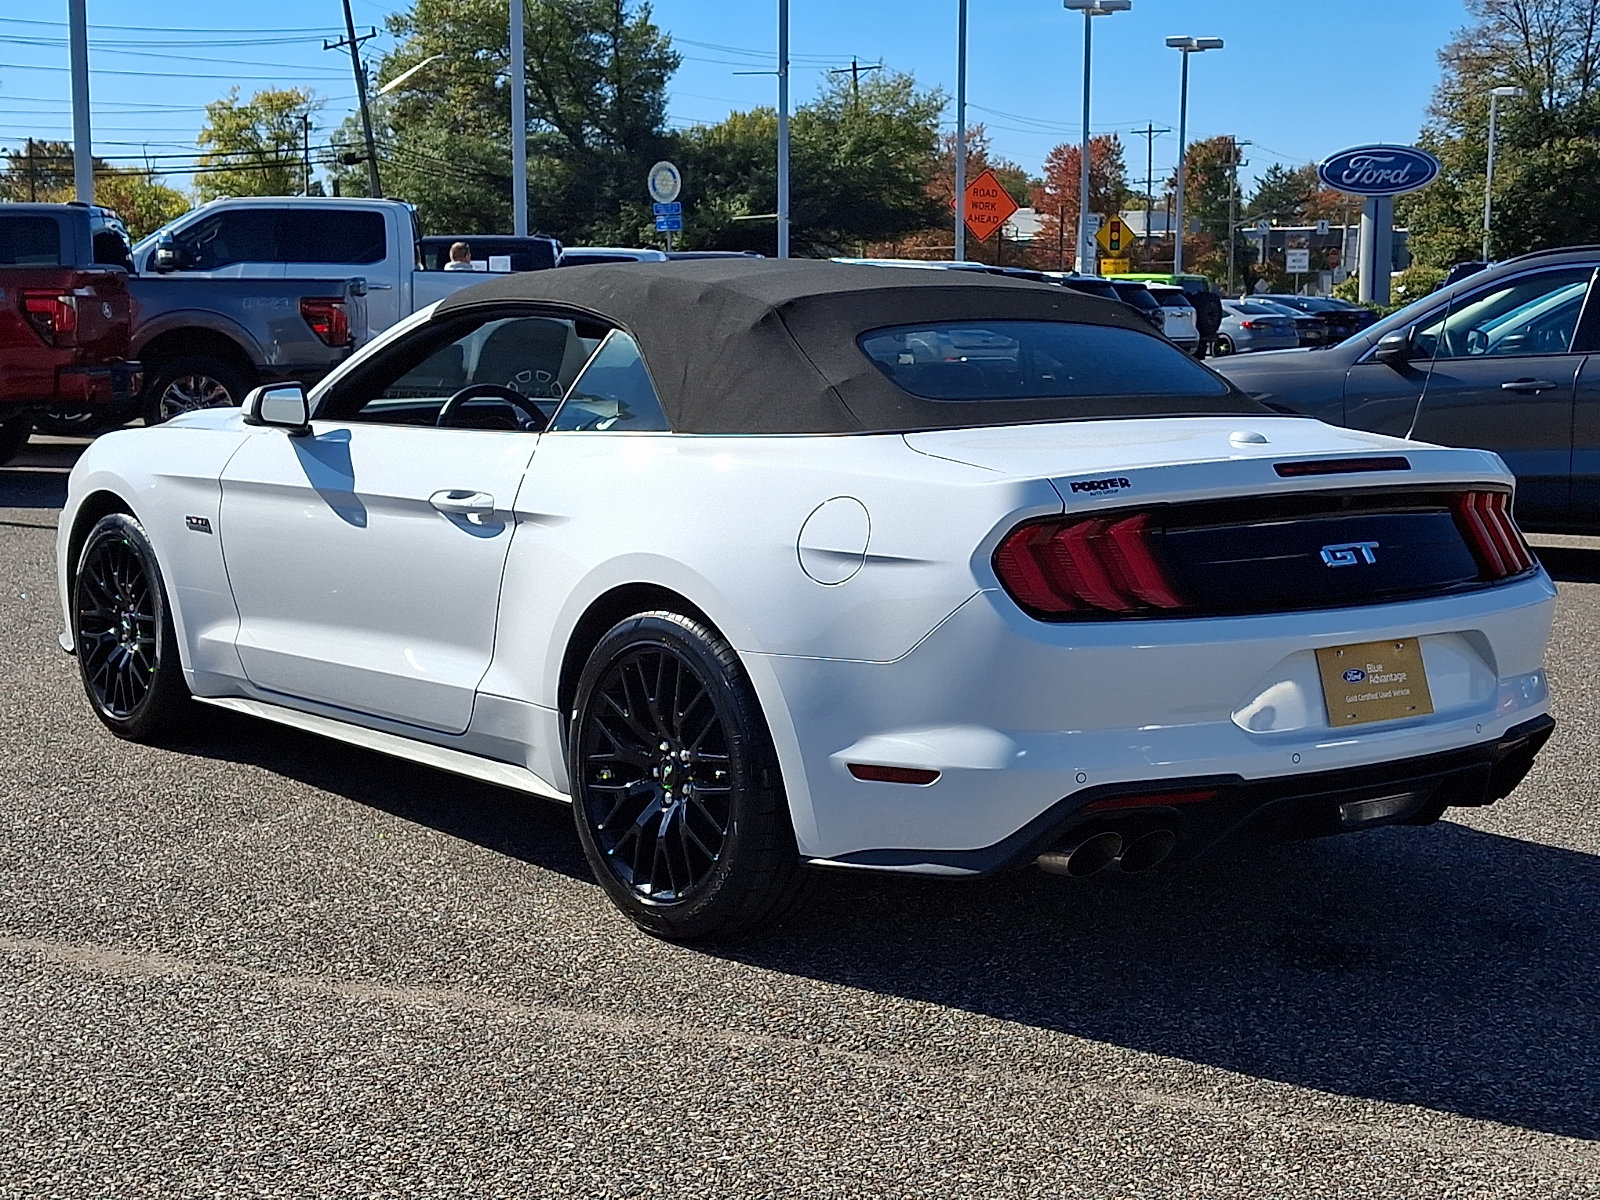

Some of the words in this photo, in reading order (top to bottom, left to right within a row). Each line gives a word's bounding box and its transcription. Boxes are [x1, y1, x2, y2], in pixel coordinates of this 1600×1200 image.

[1341, 155, 1413, 184] Ford
[972, 187, 998, 198] ROAD
[971, 201, 997, 211] WORK
[966, 214, 999, 224] AHEAD
[1069, 477, 1132, 493] PORTER
[1320, 541, 1380, 567] GT
[1366, 663, 1383, 673] Blue
[1369, 672, 1407, 684] Advantage
[1345, 695, 1358, 703] Gold
[1358, 692, 1379, 701] Certified
[1379, 690, 1392, 698] Used
[1393, 689, 1411, 697] Vehicle
